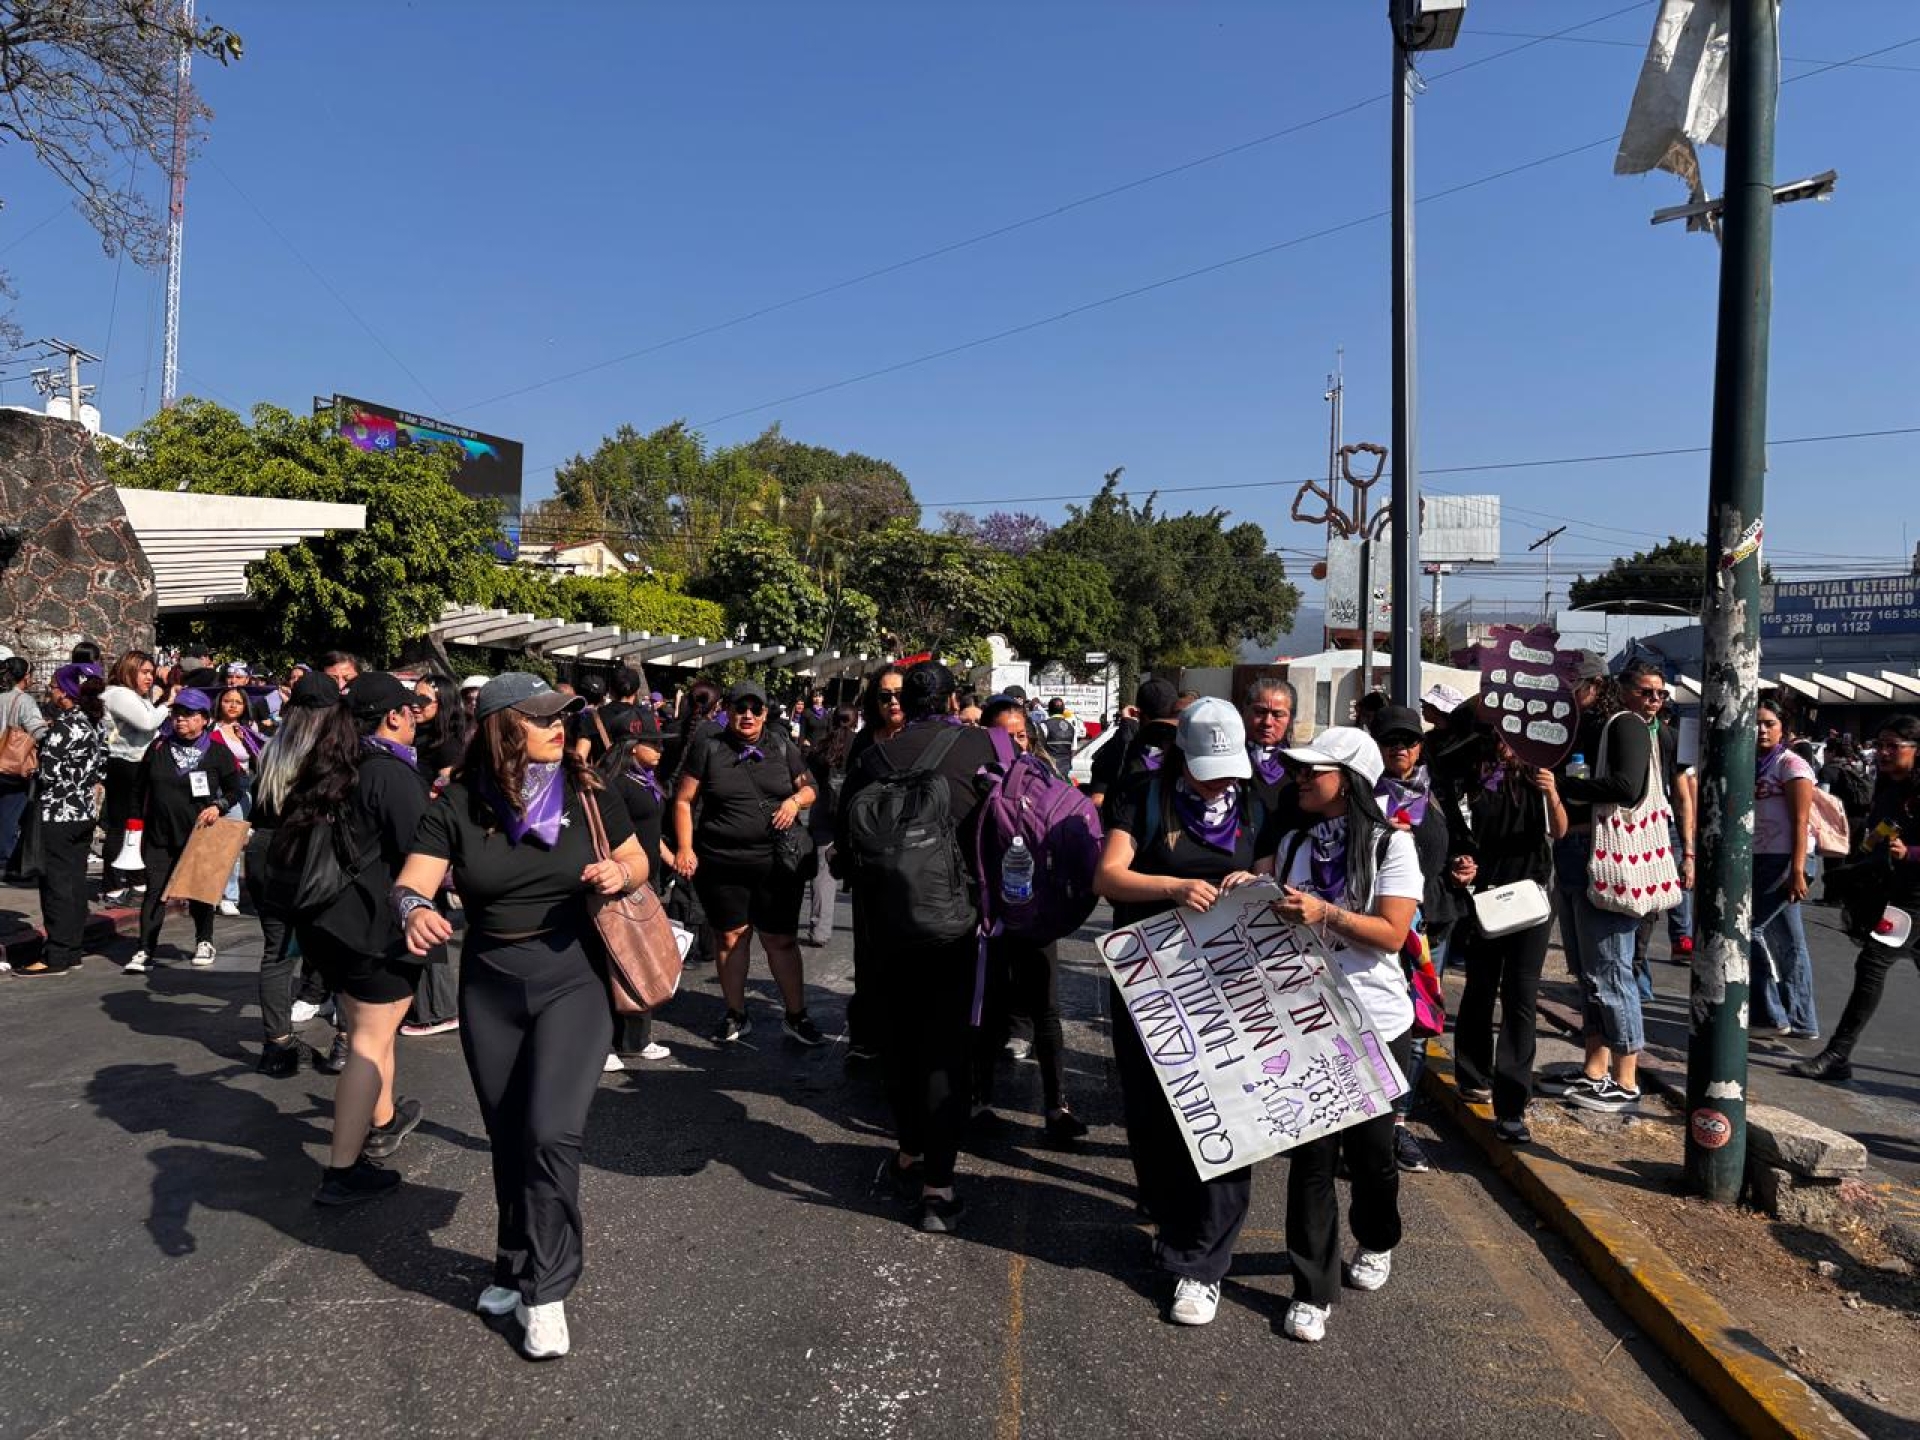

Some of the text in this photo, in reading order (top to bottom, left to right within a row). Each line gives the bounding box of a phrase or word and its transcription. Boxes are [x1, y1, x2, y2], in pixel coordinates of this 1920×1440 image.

[1778, 582, 1847, 597] HOSPITAL
[1785, 612, 1813, 623] 3528
[1851, 611, 1872, 621] 777
[1877, 609, 1899, 619] 165
[1813, 592, 1914, 609] TLALTENANGO
[1790, 621, 1871, 634] 777 601 1123
[1103, 931, 1156, 989] NO
[1202, 924, 1285, 1051] MALTRATA
[1248, 907, 1332, 1036] NI MATA
[1142, 912, 1245, 1070] HUMILLA NI
[1135, 996, 1192, 1059] AMA
